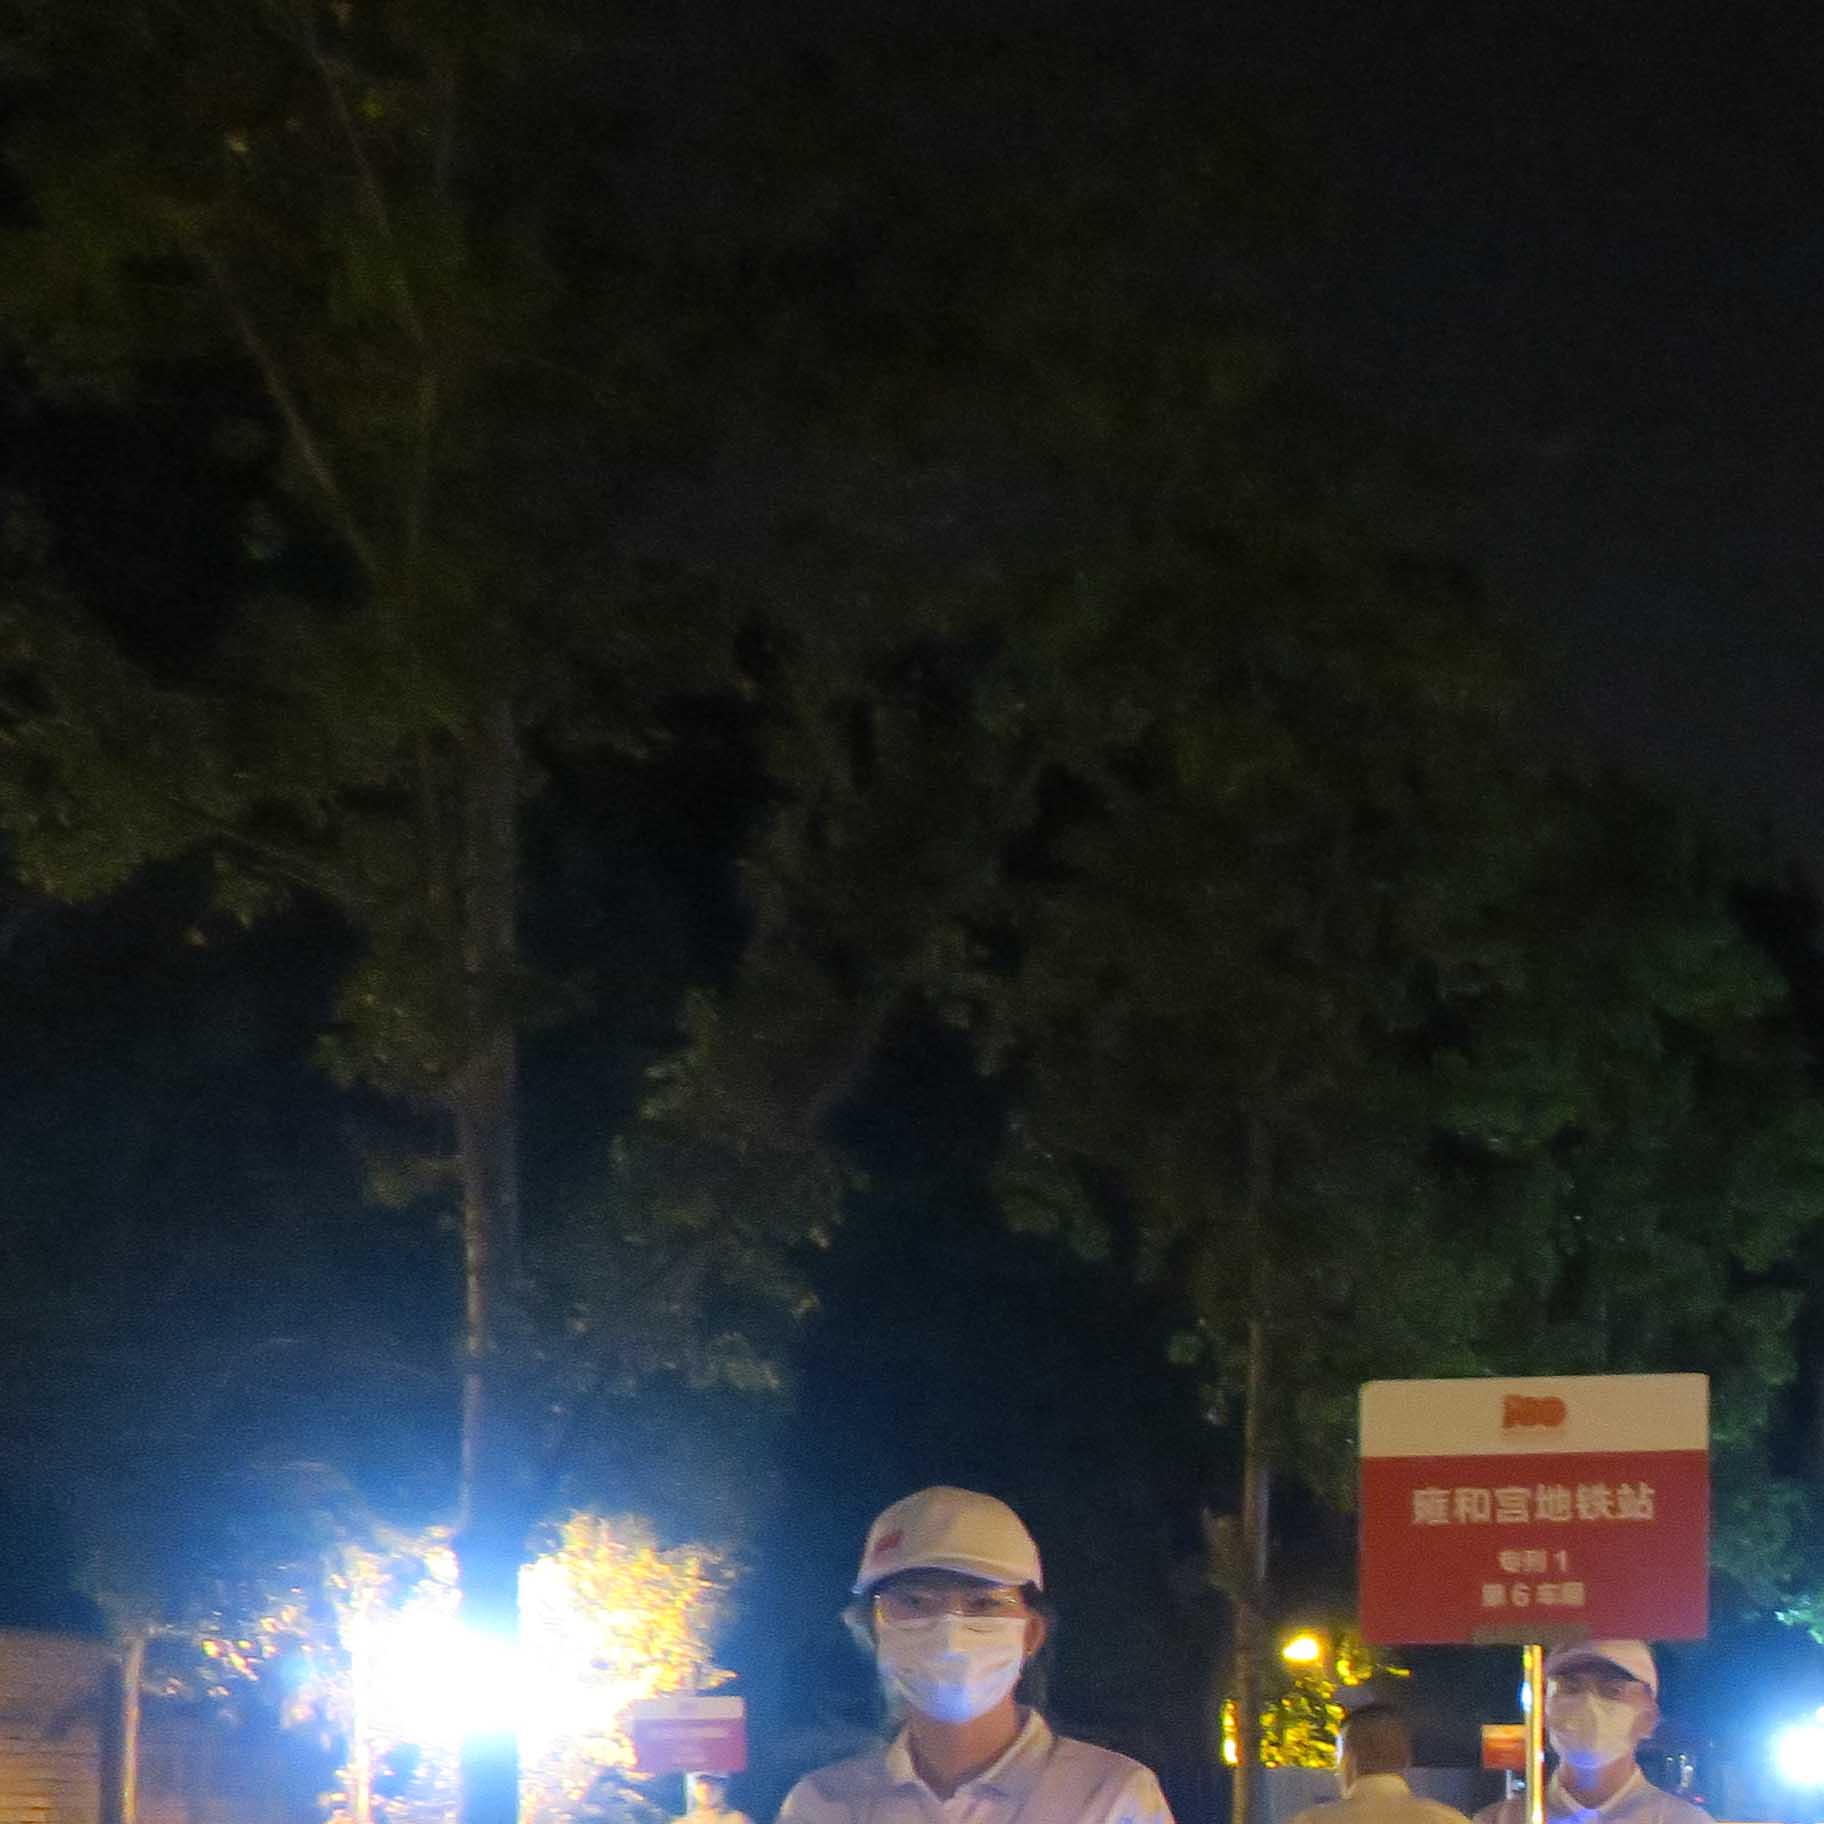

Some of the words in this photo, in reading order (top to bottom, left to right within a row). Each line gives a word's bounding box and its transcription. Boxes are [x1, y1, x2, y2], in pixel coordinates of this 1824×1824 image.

[1411, 1481, 1655, 1525] 雍和宫地铁站
